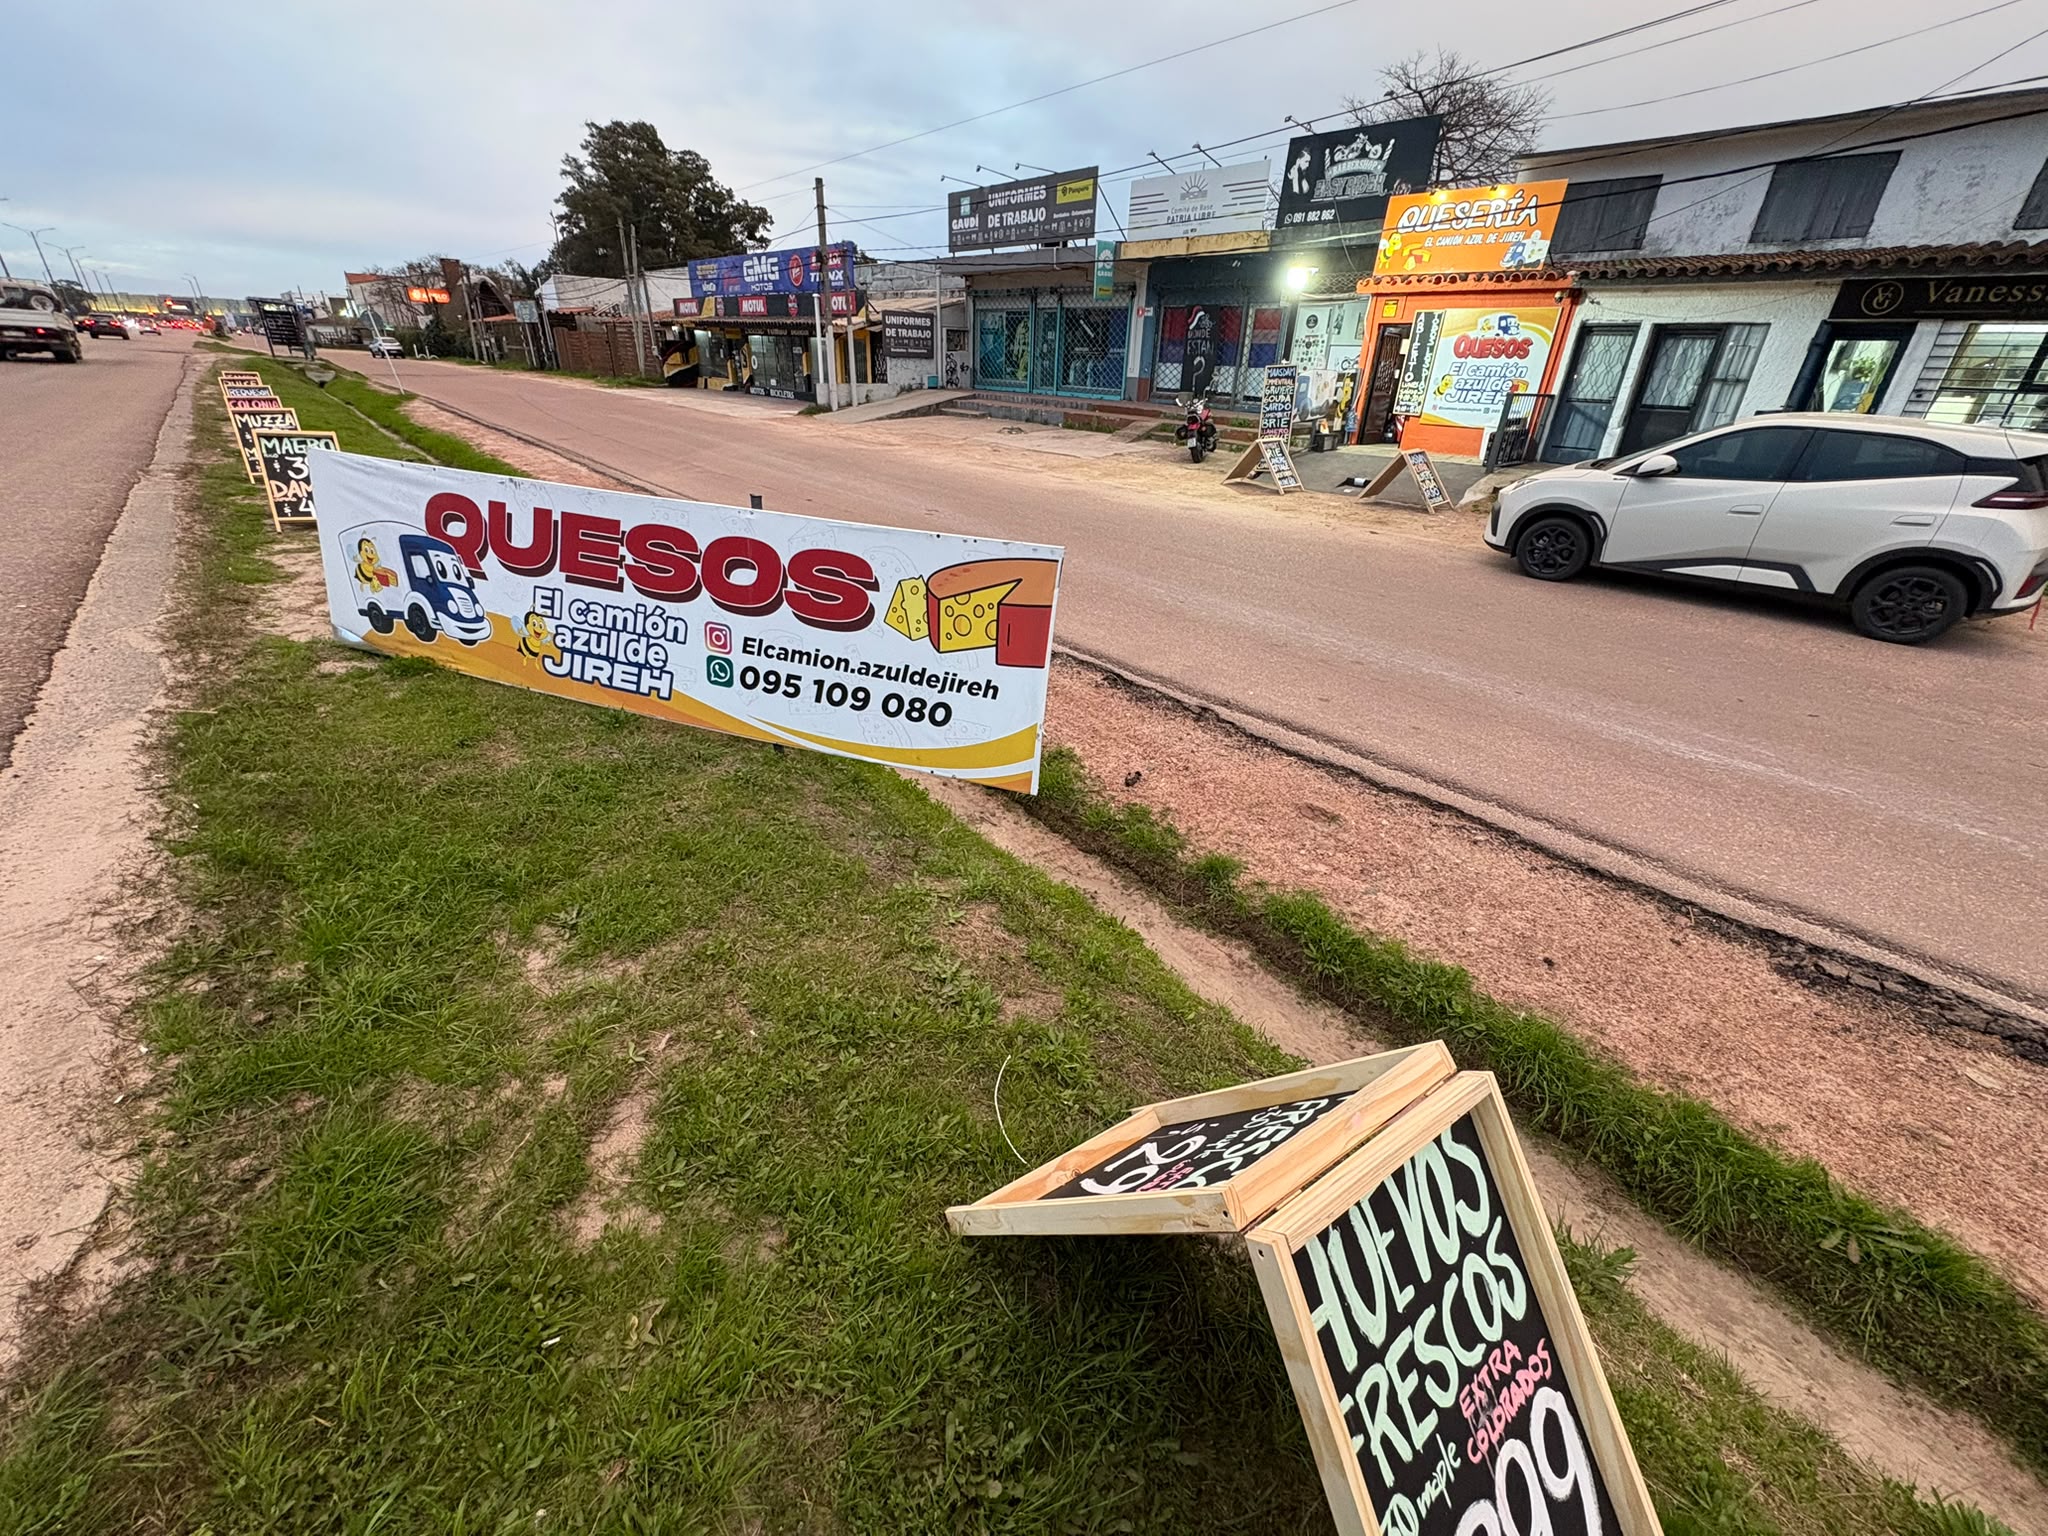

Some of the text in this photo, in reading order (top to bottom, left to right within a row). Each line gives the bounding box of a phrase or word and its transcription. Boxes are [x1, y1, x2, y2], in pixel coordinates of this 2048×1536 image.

[988, 185, 1046, 208] UNIFORMES
[988, 207, 1046, 228] DE TRABAJO
[1167, 214, 1191, 223] PATRIA
[1194, 211, 1216, 220] LIBRE
[1397, 189, 1538, 233] QUESERÍA
[1424, 238, 1433, 247] EL
[1464, 234, 1483, 245] AZUL
[1486, 233, 1498, 244] DE
[1499, 231, 1527, 243] JIREH
[743, 255, 780, 282] GMG
[751, 282, 774, 291] MOTOS
[1928, 280, 2048, 303] Vaness
[742, 300, 764, 312] MOTUL
[885, 315, 931, 327] UNIFORMES
[885, 328, 931, 338] DE TRABAJO
[1404, 312, 1425, 382] ABIERTO
[1453, 334, 1534, 359] QUESOS
[1449, 362, 1528, 378] El camión
[229, 400, 279, 409] COLONIA
[1263, 403, 1292, 412] SARDO
[1264, 395, 1291, 403] GOUDA
[234, 413, 295, 428] MUZZA
[1261, 418, 1289, 429] BRIE
[425, 492, 880, 632] QUESOS
[533, 585, 688, 645] El camión
[542, 650, 674, 701] JIREH
[742, 636, 1000, 701] Elcamion.azuldejireh
[739, 666, 953, 727] 095 109 080
[1459, 1338, 1522, 1420] EXTRA
[1467, 1337, 1553, 1465] COLORADOS
[1415, 1433, 1462, 1518] maple
